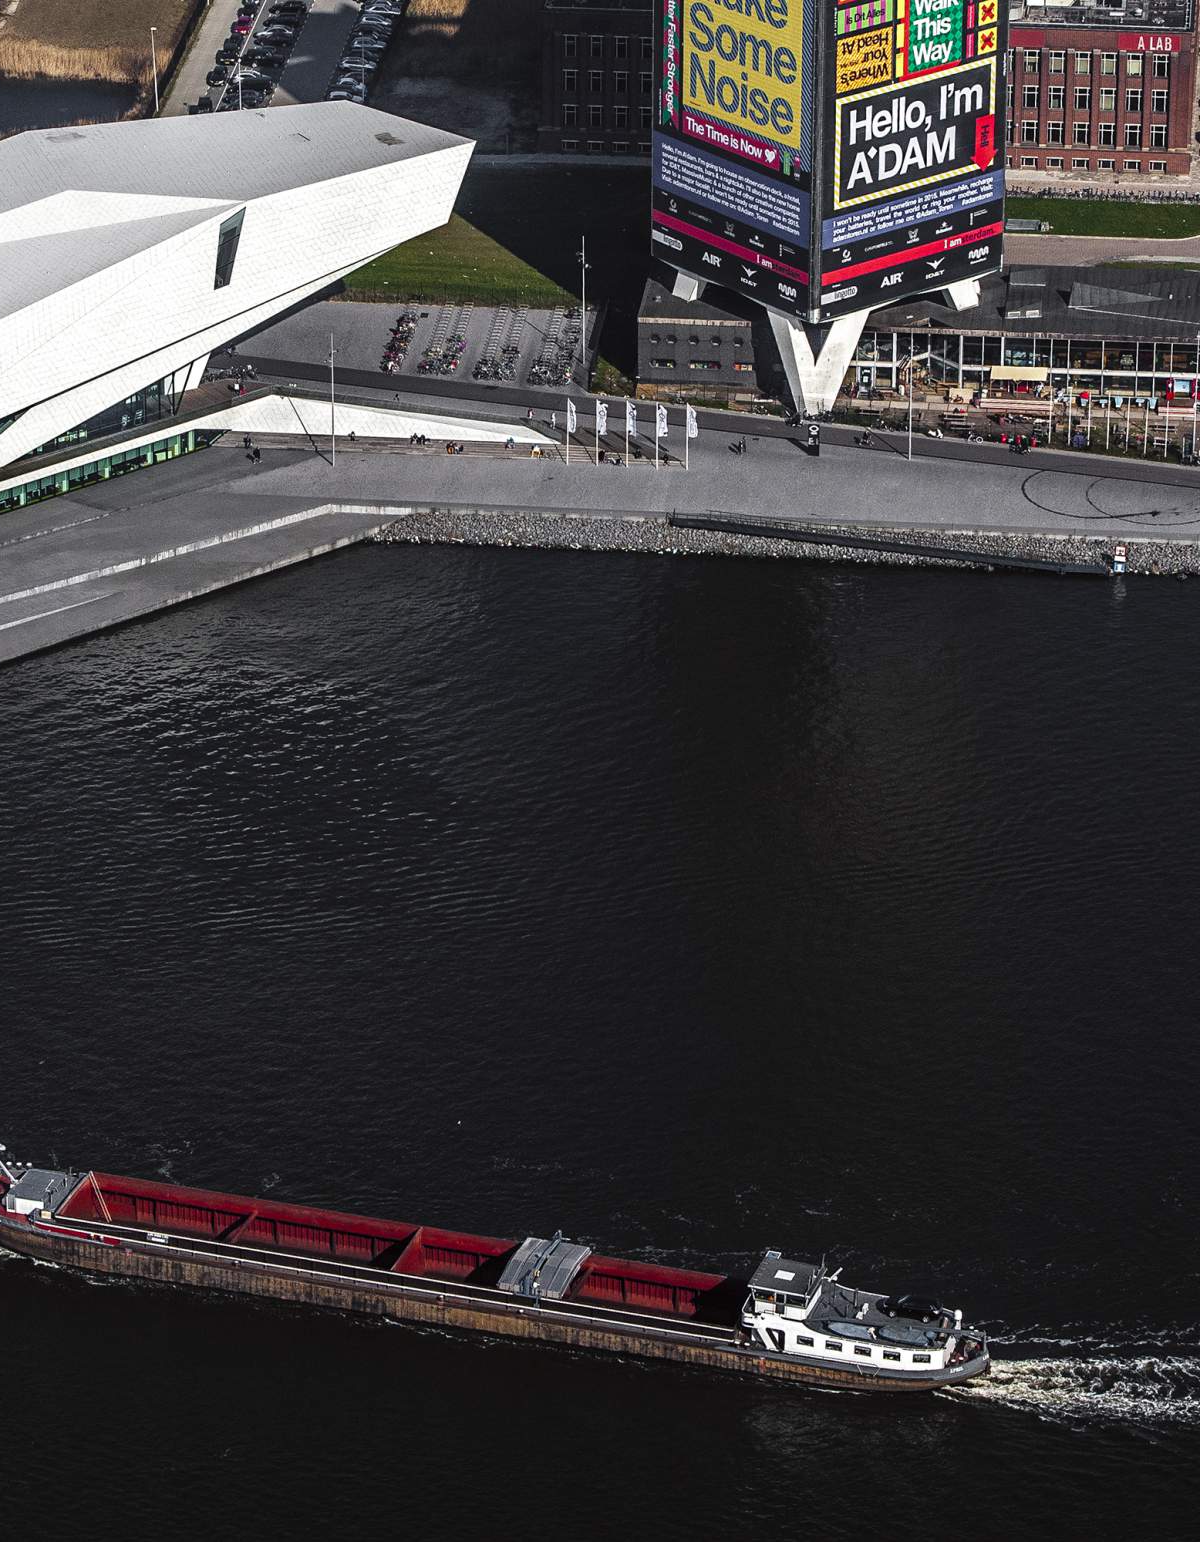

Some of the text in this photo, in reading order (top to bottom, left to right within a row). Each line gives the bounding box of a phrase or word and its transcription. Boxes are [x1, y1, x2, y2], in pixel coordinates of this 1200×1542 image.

[913, 13, 952, 41] This
[668, 22, 676, 61] Faster
[689, 3, 797, 84] Some
[842, 32, 888, 55] Head At
[913, 41, 953, 66] Way
[1138, 36, 1172, 50] A LAB
[861, 48, 888, 63] Your
[841, 63, 888, 85] Where's
[666, 61, 675, 116] Stronger
[690, 52, 794, 135] Noise
[849, 83, 983, 145] Hello, I'm
[686, 117, 763, 158] The Time is Now
[847, 126, 956, 190] A'DAM
[833, 227, 846, 237] your
[876, 213, 891, 223] travel
[905, 205, 920, 215] world
[944, 195, 956, 205] your
[861, 210, 876, 220] ready
[891, 199, 917, 211] sometime
[877, 221, 894, 230] follow
[944, 239, 947, 249] I
[757, 254, 760, 264] I
